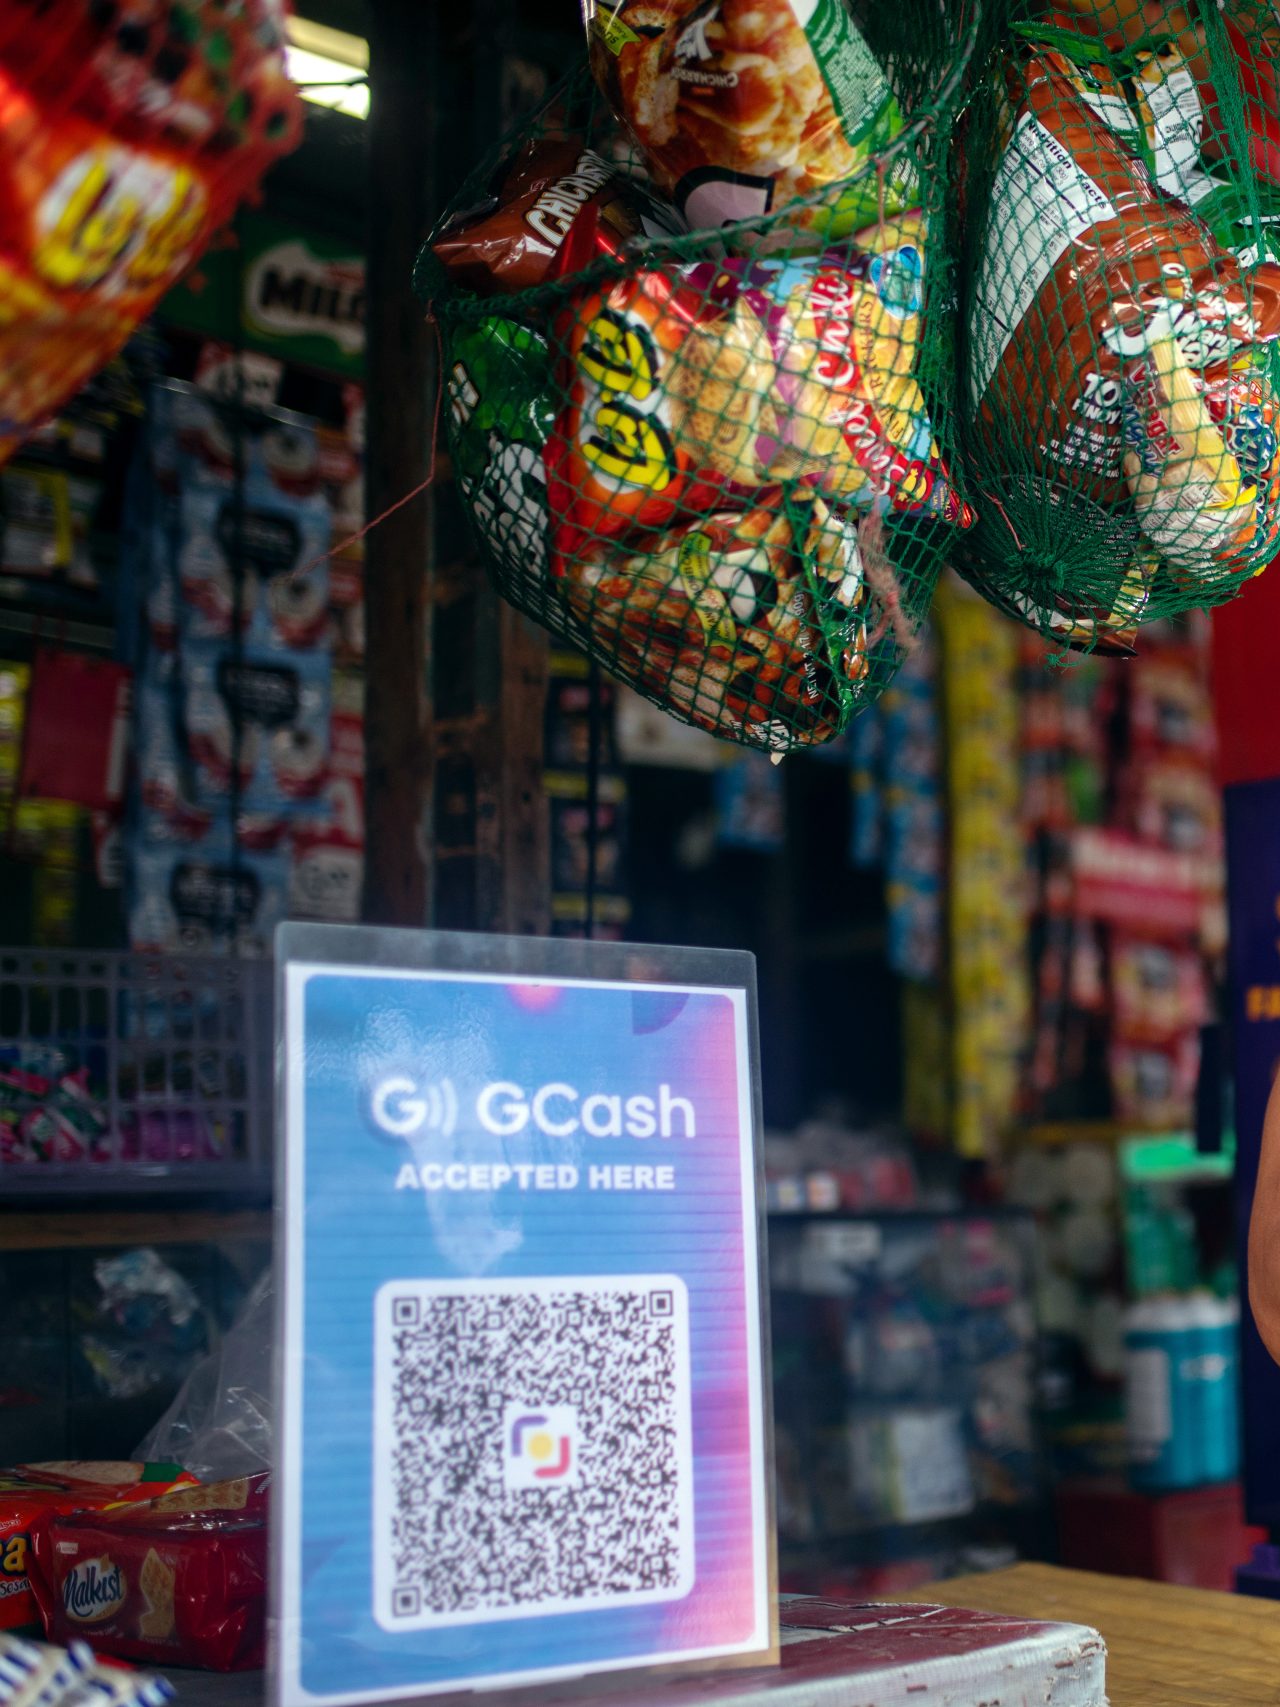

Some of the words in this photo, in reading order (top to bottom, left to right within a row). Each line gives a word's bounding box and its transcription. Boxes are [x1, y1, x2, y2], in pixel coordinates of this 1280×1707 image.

[1129, 362, 1184, 458] Vinegar
[476, 1083, 696, 1137] GCash
[395, 1163, 579, 1191] ACCEPTED
[589, 1164, 675, 1190] HERE
[63, 1564, 122, 1618] Malkist
